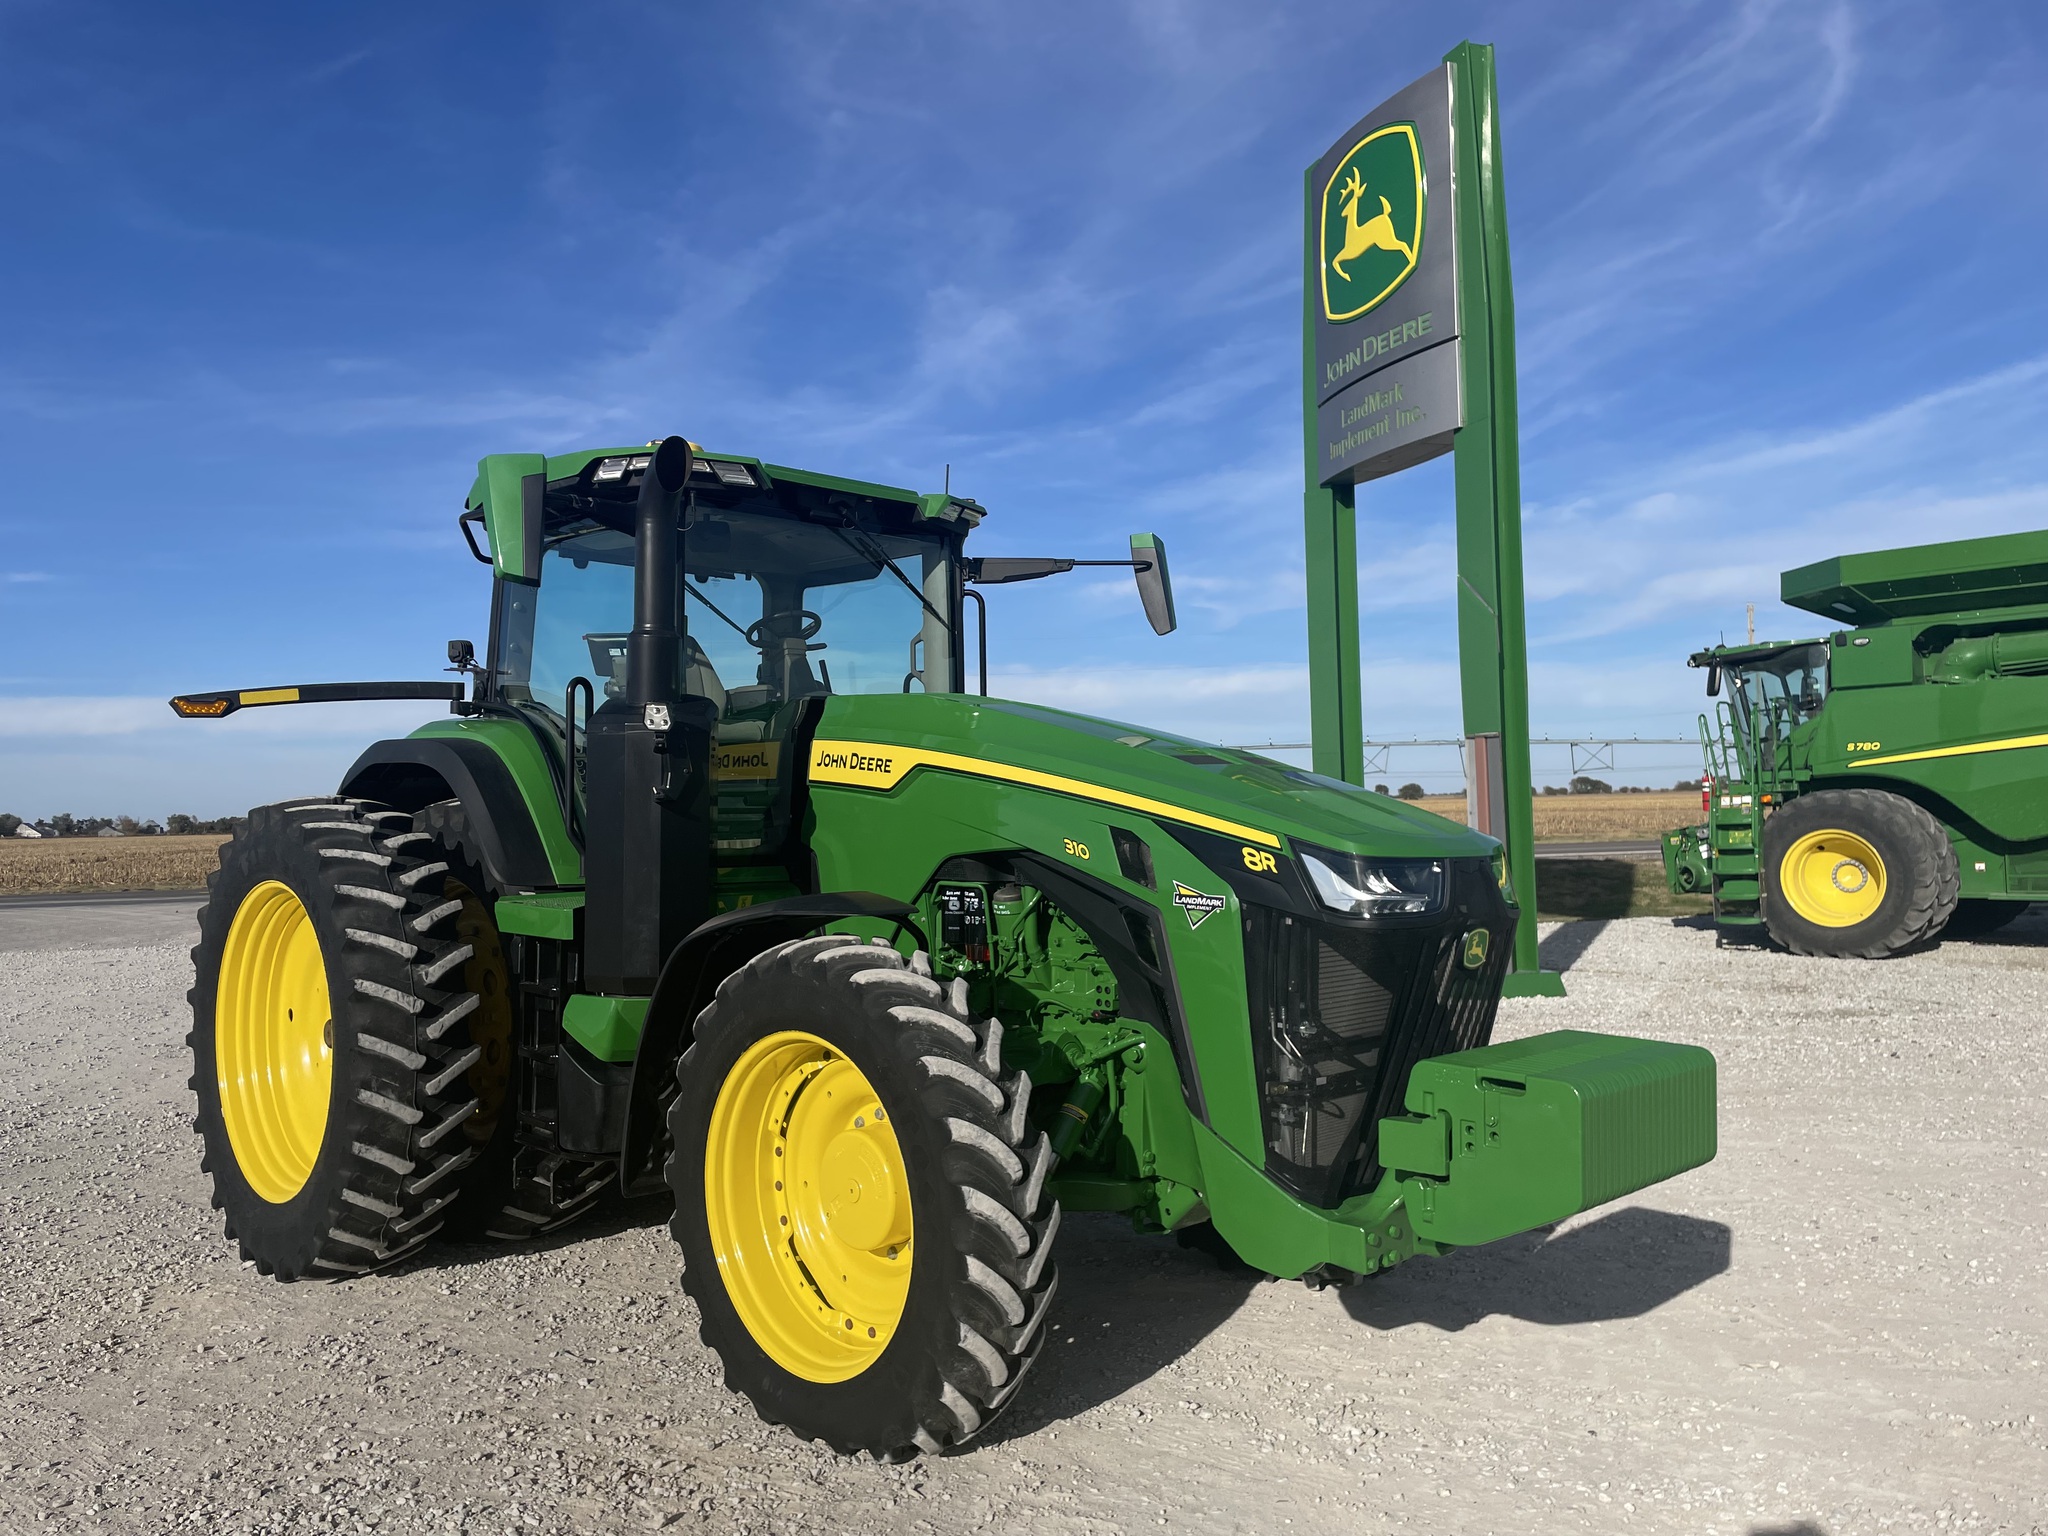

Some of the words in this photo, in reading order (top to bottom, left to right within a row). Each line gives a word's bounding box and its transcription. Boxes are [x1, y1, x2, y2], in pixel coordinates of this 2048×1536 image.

[1323, 347, 1361, 389] JOHN
[1363, 311, 1433, 363] DEERE
[1341, 381, 1403, 429] LandMark
[1329, 414, 1390, 460] Implement
[1396, 406, 1427, 430] Inc.
[816, 750, 848, 768] JOHN
[849, 752, 893, 774] DEERE
[1063, 837, 1090, 860] 310
[1241, 846, 1278, 874] 8R
[1175, 895, 1223, 907] LANDMARK
